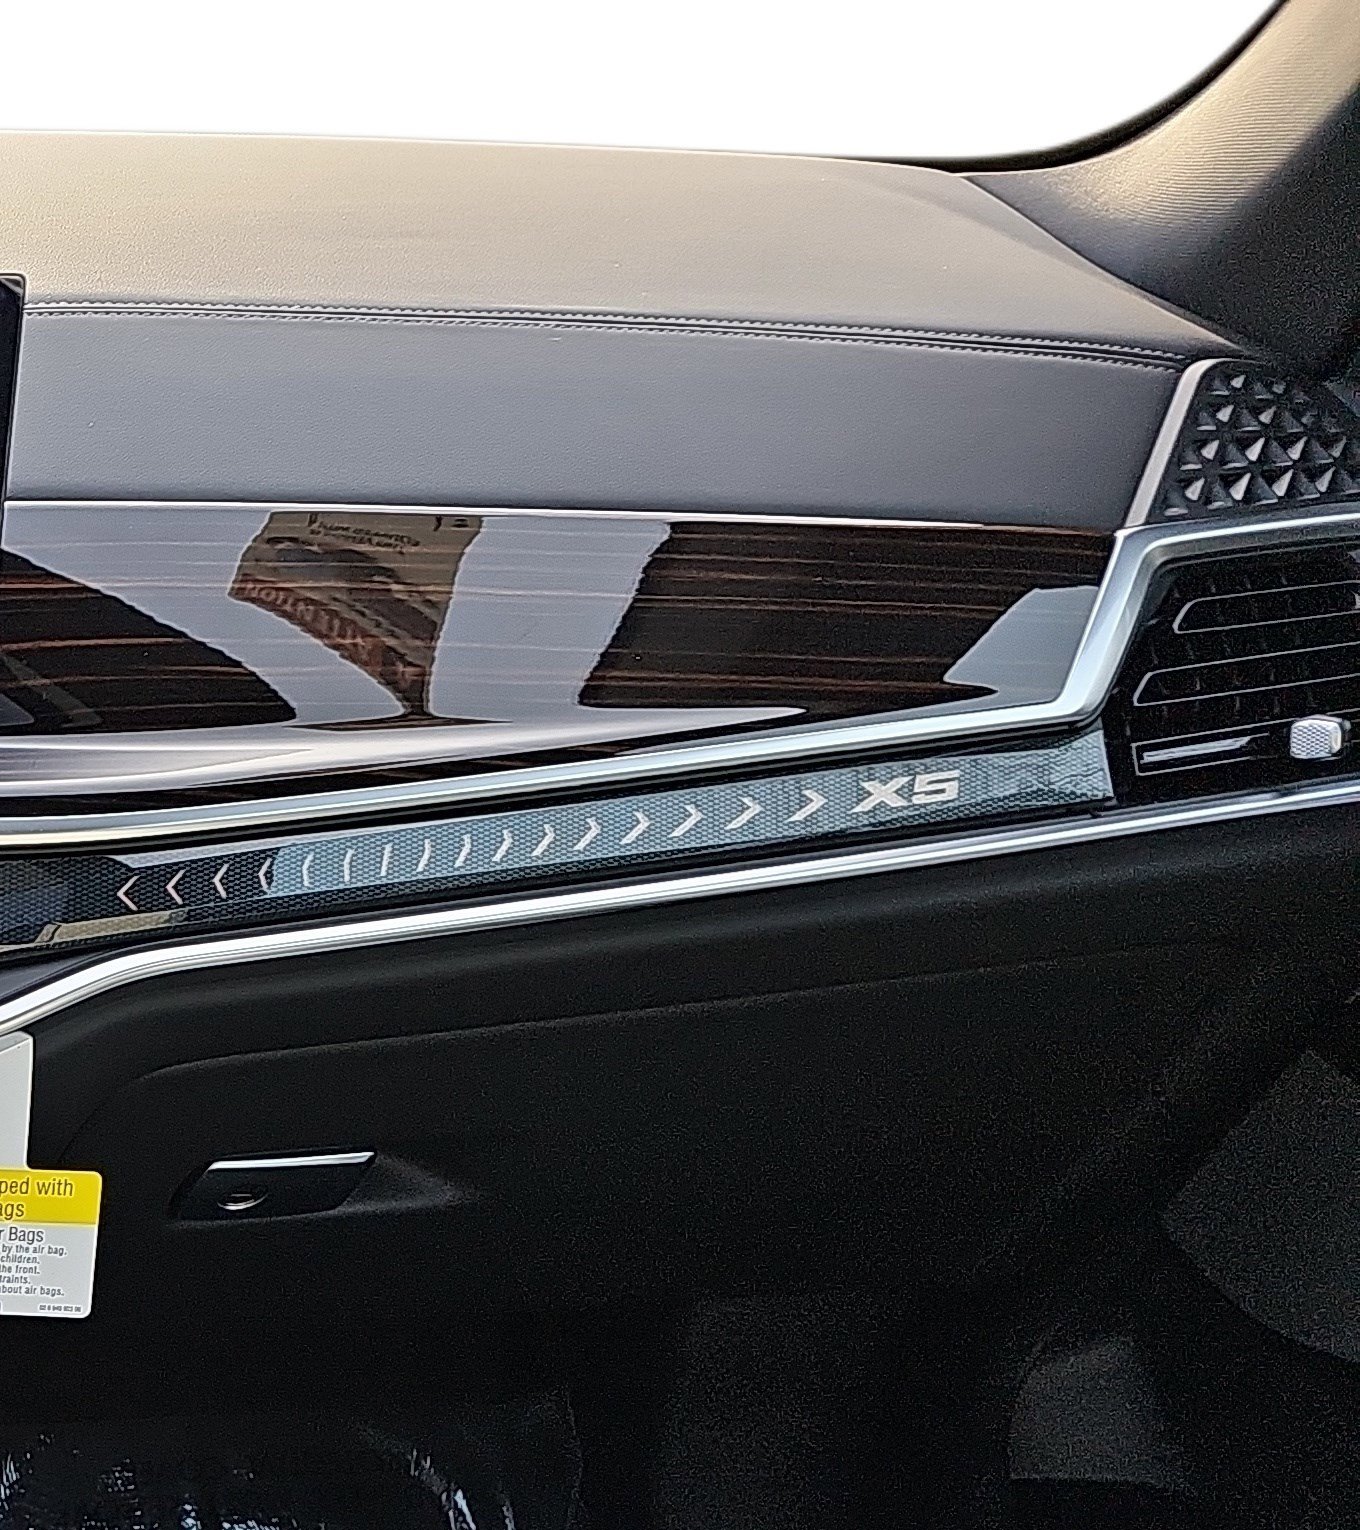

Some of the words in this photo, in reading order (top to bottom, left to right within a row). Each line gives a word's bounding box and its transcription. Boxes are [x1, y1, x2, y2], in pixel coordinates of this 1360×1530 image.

[847, 769, 961, 813] X5
[37, 1178, 74, 1196] with
[8, 1226, 45, 1245] Bags
[2, 1243, 13, 1254] by
[15, 1244, 30, 1254] the
[32, 1245, 45, 1254] air
[48, 1245, 68, 1256] bag.
[1, 1255, 41, 1265] children.
[15, 1265, 40, 1275] front.
[25, 1285, 37, 1294] air
[40, 1286, 65, 1297] bags.
